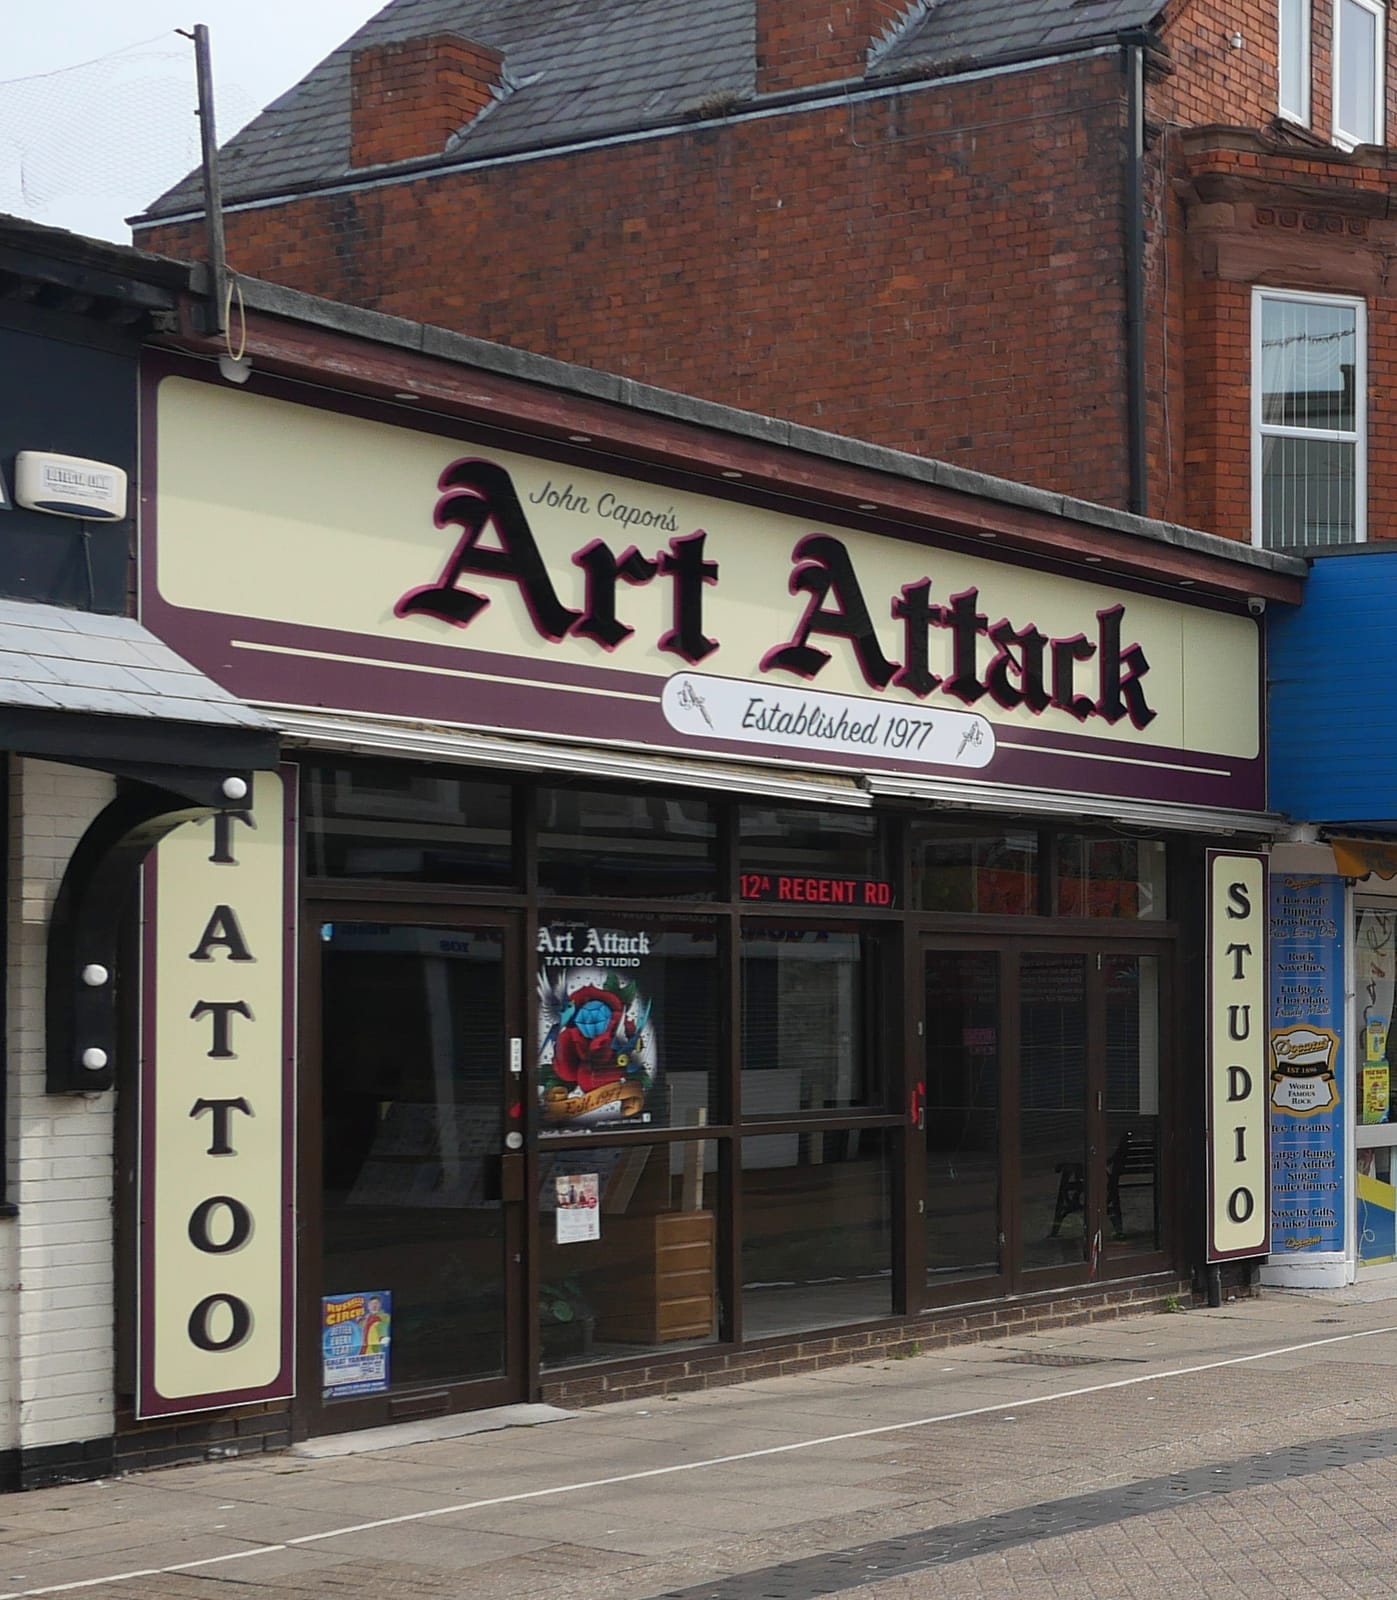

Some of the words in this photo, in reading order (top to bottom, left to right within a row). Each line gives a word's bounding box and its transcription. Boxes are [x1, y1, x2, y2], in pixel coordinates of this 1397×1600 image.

[529, 481, 590, 513] John
[597, 493, 678, 531] Capon's
[393, 456, 719, 666] Art
[759, 533, 1157, 730] Attack
[742, 698, 880, 745] Established
[884, 717, 934, 751] 1977
[739, 873, 772, 898] 12A
[778, 876, 857, 904] REGENT
[864, 881, 891, 905] RD
[537, 927, 574, 953] Art
[583, 928, 651, 954] Attack
[545, 956, 594, 967] TATTOO
[597, 957, 641, 967] STUDIO
[1277, 963, 1327, 972] Novelties
[1288, 952, 1315, 961] Rock
[1226, 882, 1254, 1224] STUDIO
[187, 809, 257, 1353] TATTOO
[1272, 1151, 1300, 1160] arge
[1303, 1149, 1337, 1160] Range
[1302, 1159, 1336, 1169] Added
[1287, 1172, 1320, 1182] Sugar
